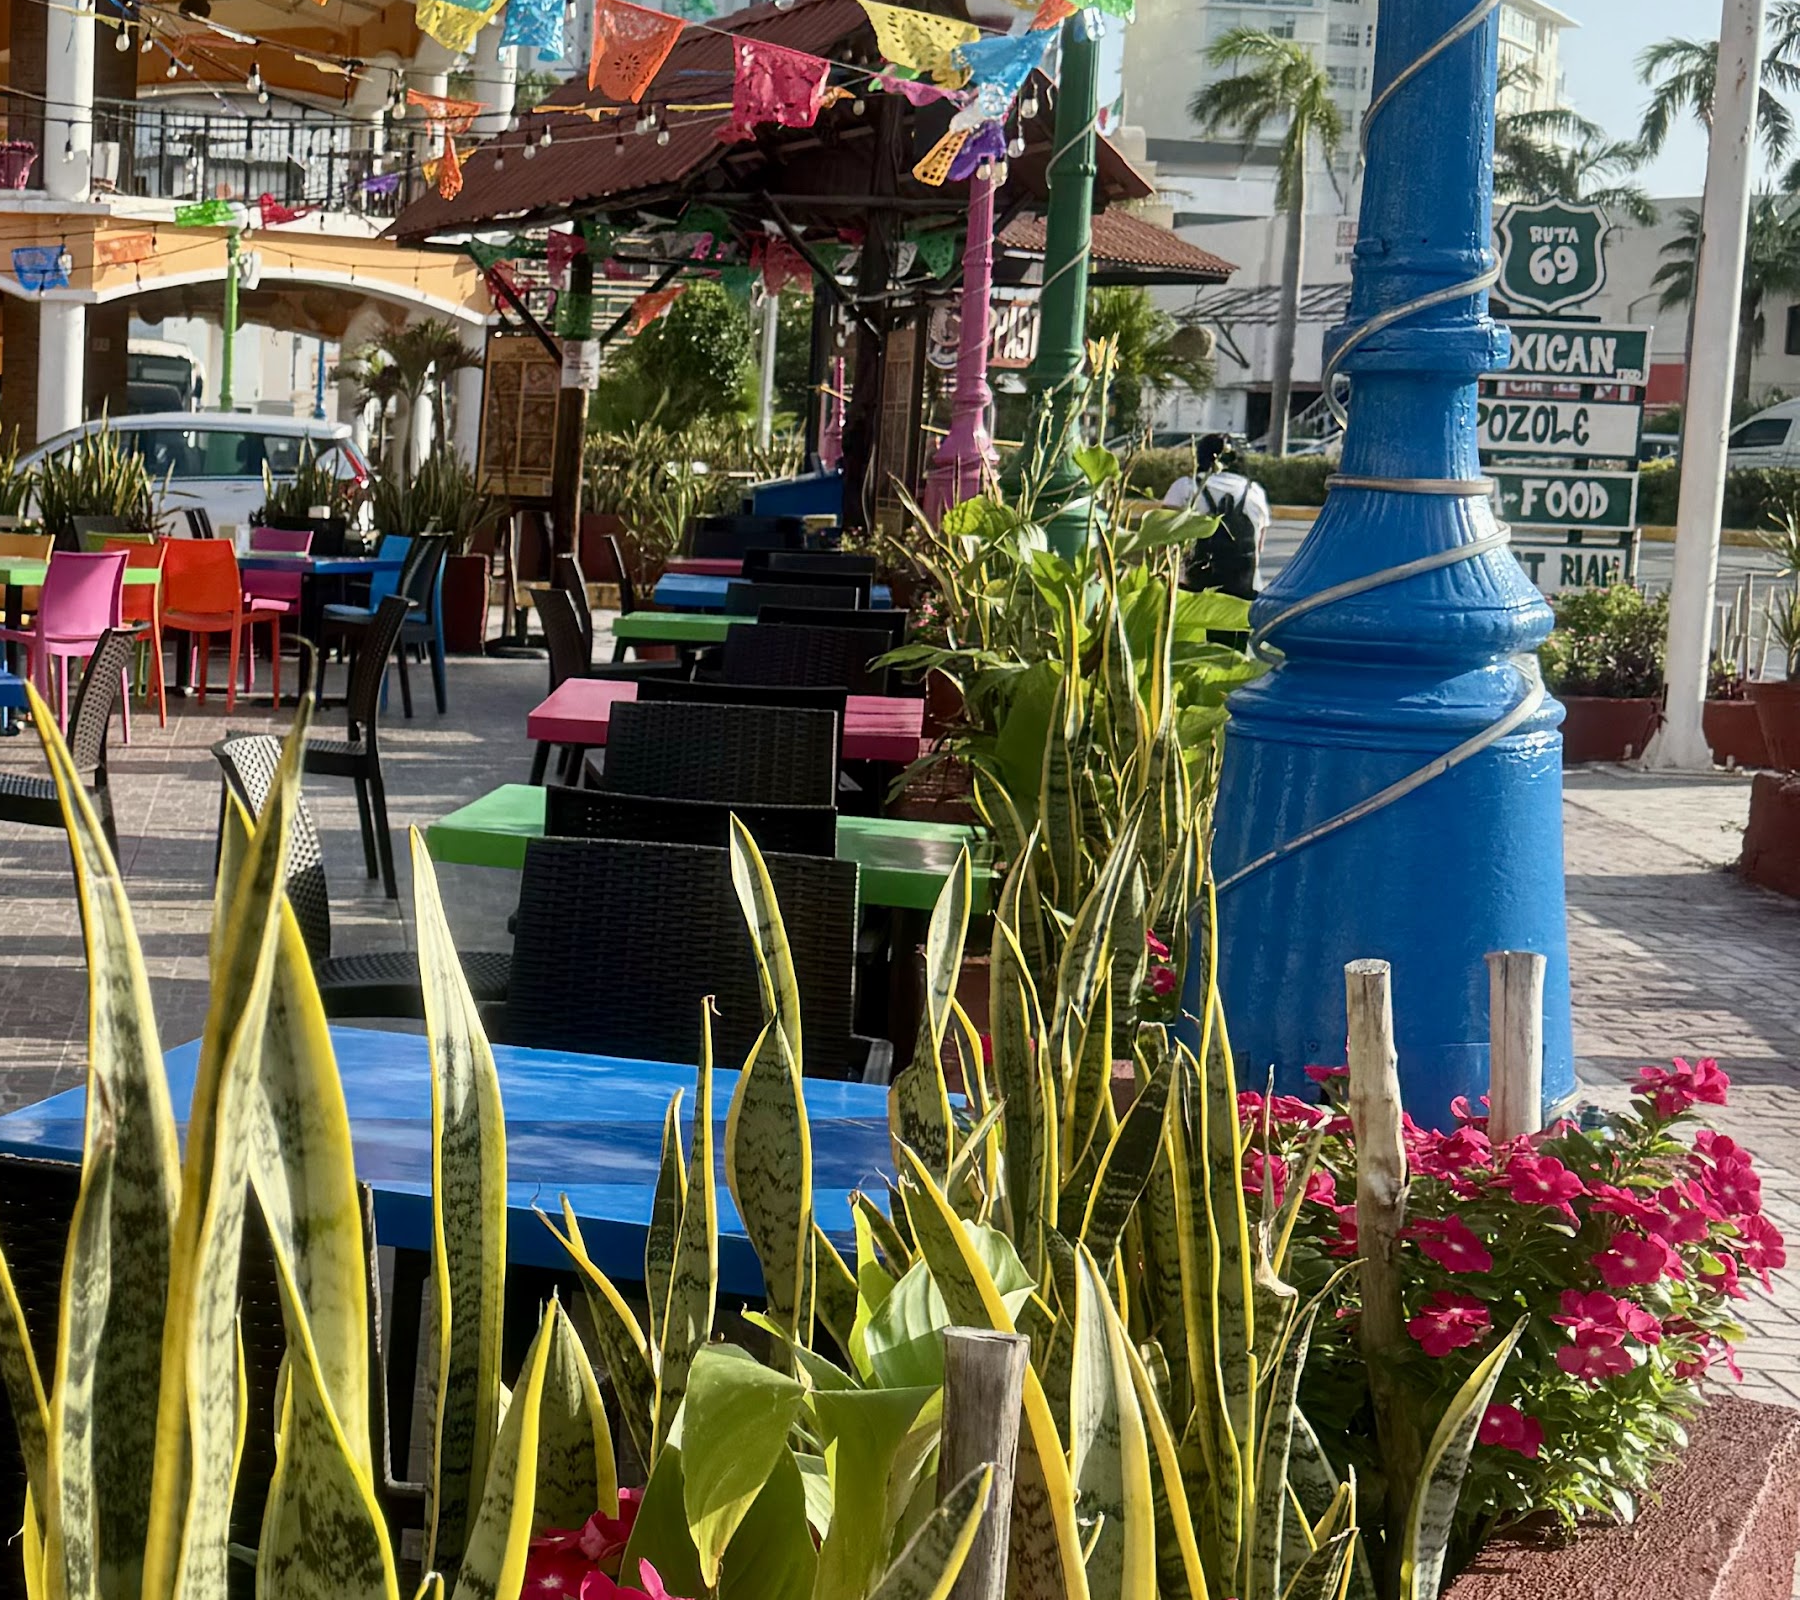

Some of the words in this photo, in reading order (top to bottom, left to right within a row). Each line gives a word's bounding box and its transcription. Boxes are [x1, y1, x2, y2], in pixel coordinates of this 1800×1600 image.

[1529, 225, 1579, 246] RUTA
[1529, 243, 1579, 286] 69
[1509, 332, 1618, 376] XICAN
[1520, 478, 1609, 519] FOOD
